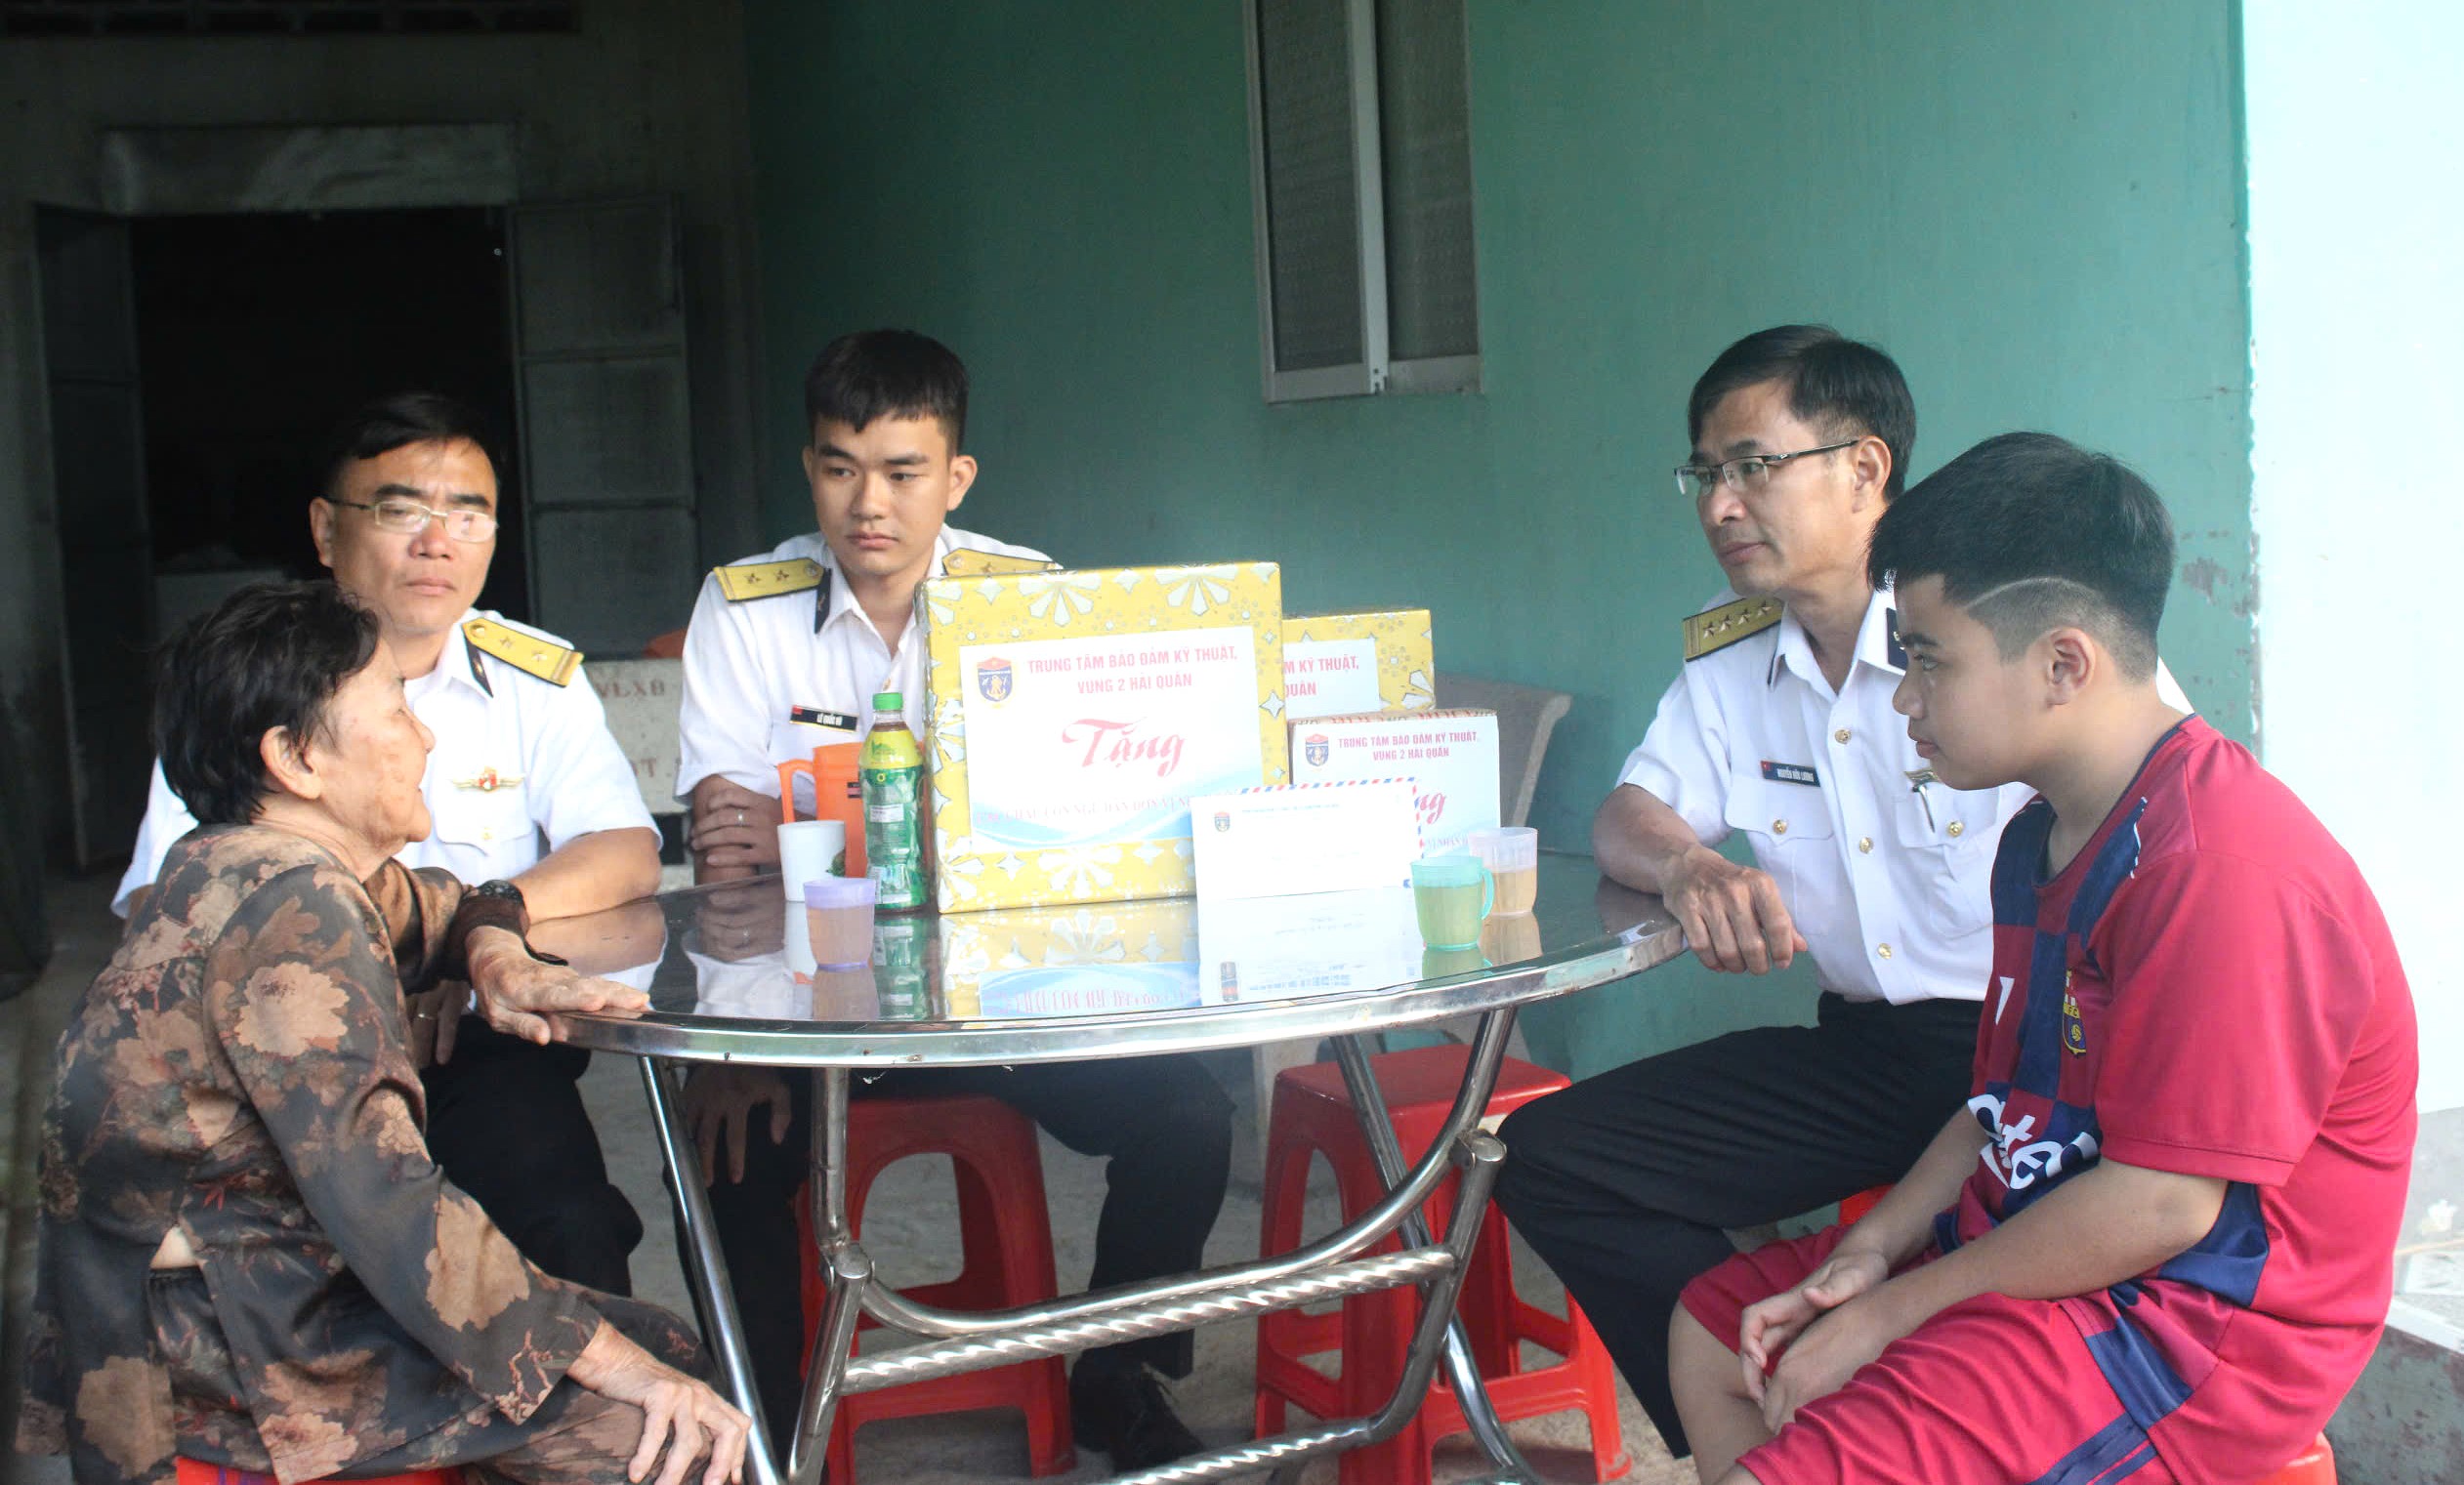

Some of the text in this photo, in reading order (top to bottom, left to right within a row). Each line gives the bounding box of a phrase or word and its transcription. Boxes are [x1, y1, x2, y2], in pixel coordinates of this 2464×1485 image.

[1027, 657, 1071, 674] TRUNG
[1117, 679, 1126, 691] 2
[1062, 717, 1185, 777] Tặng
[1338, 737, 1368, 749] TRUNG
[1399, 749, 1405, 760] 2
